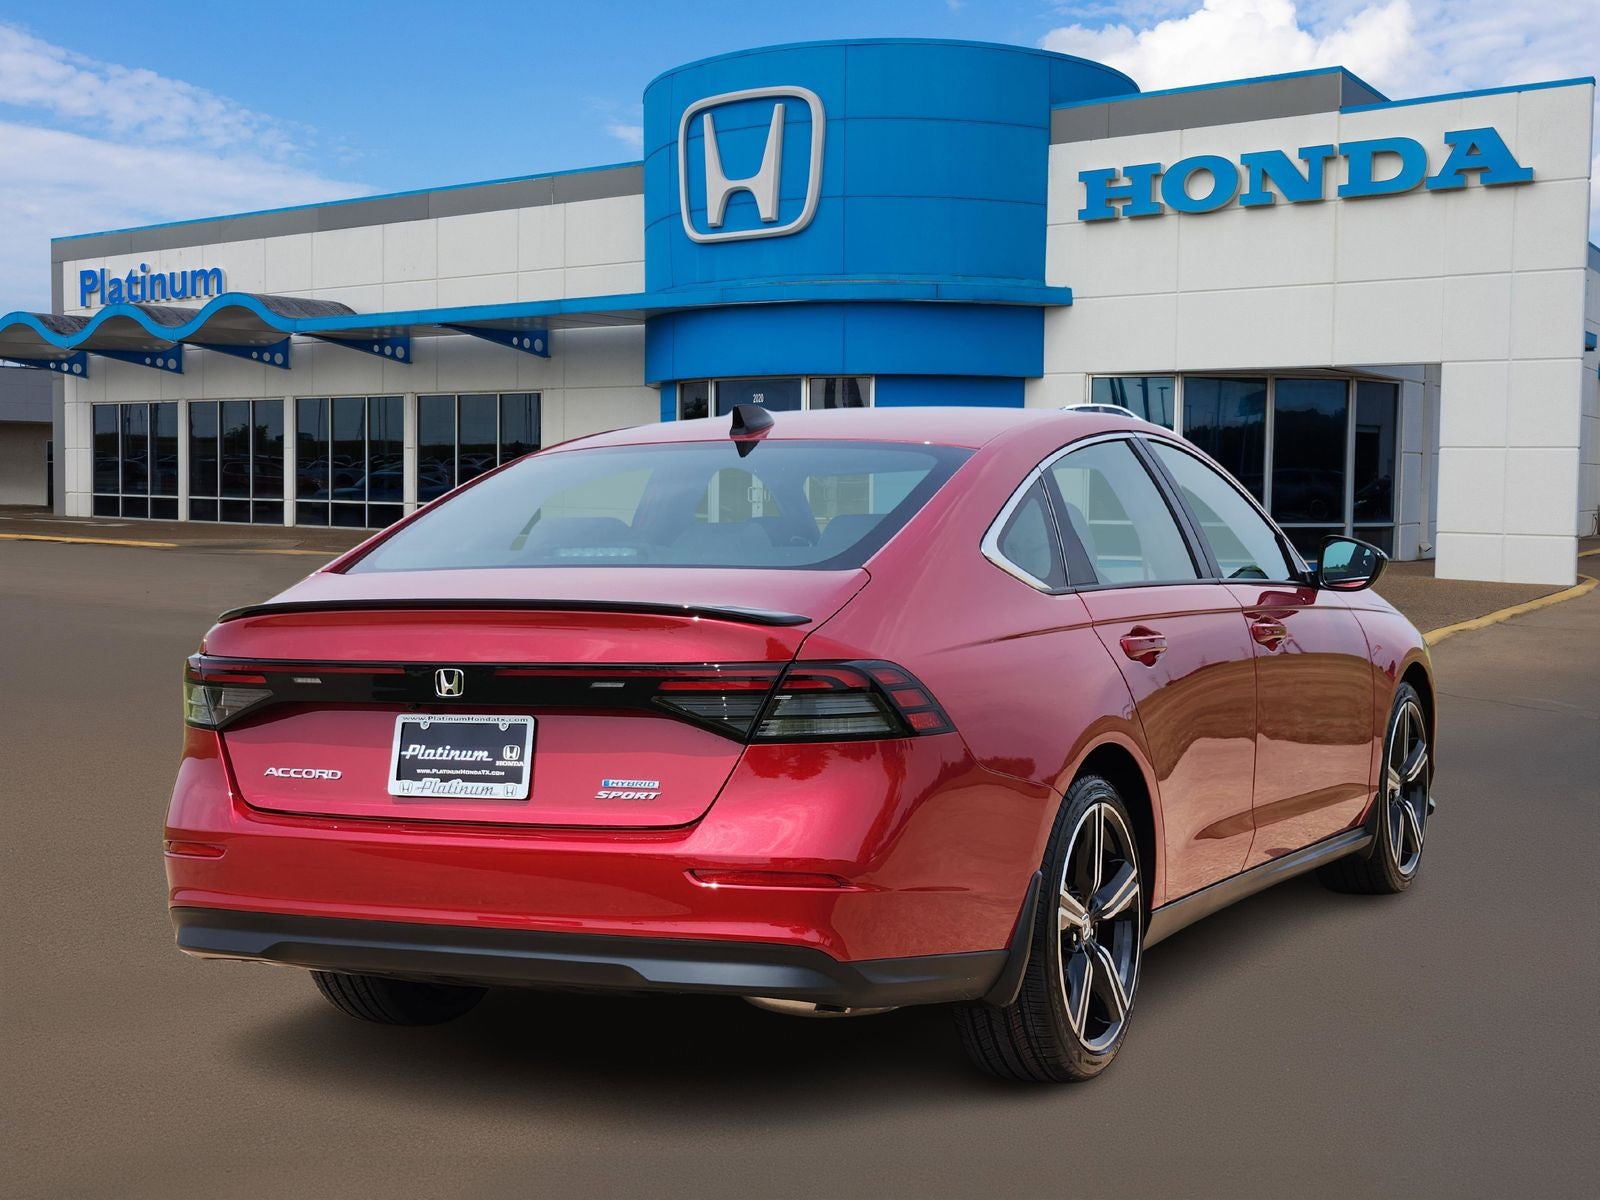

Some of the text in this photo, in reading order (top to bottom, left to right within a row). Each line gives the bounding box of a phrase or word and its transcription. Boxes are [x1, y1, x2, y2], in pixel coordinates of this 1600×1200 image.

[1078, 127, 1534, 222] HONDA
[79, 262, 227, 308] Platinum
[400, 744, 493, 762] Platinum
[264, 767, 342, 780] ACCORD
[416, 780, 499, 796] Platinum
[611, 780, 656, 788] HYBRID
[594, 790, 662, 800] SPORT
